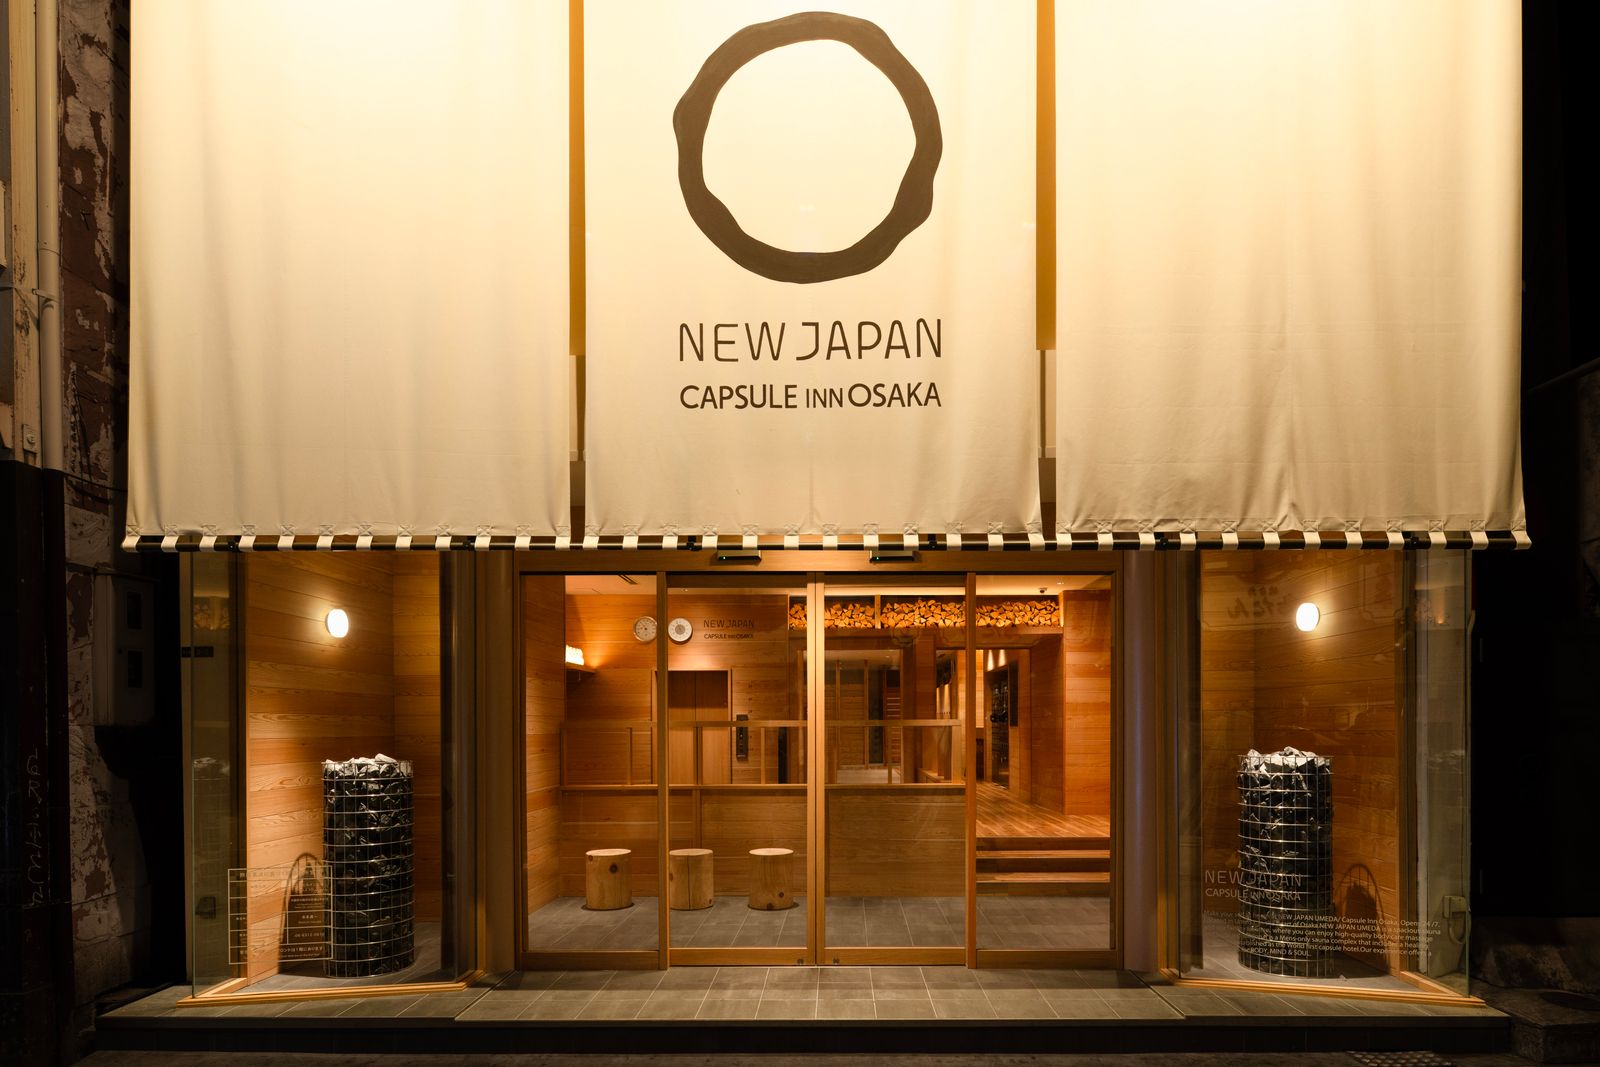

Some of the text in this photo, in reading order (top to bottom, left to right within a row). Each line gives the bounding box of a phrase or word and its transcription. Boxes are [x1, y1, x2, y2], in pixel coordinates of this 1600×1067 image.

[679, 318, 942, 362] NEW JAPAN
[680, 382, 942, 410] CAPSULE INN OSAKA
[703, 619, 754, 629] NEW JAPAN
[1204, 870, 1301, 887] NEW JAPAN
[1205, 888, 1249, 899] CAPSULE
[1266, 890, 1301, 901] OSAKA
[1341, 916, 1367, 924] Capsule
[1330, 937, 1358, 945] complex
